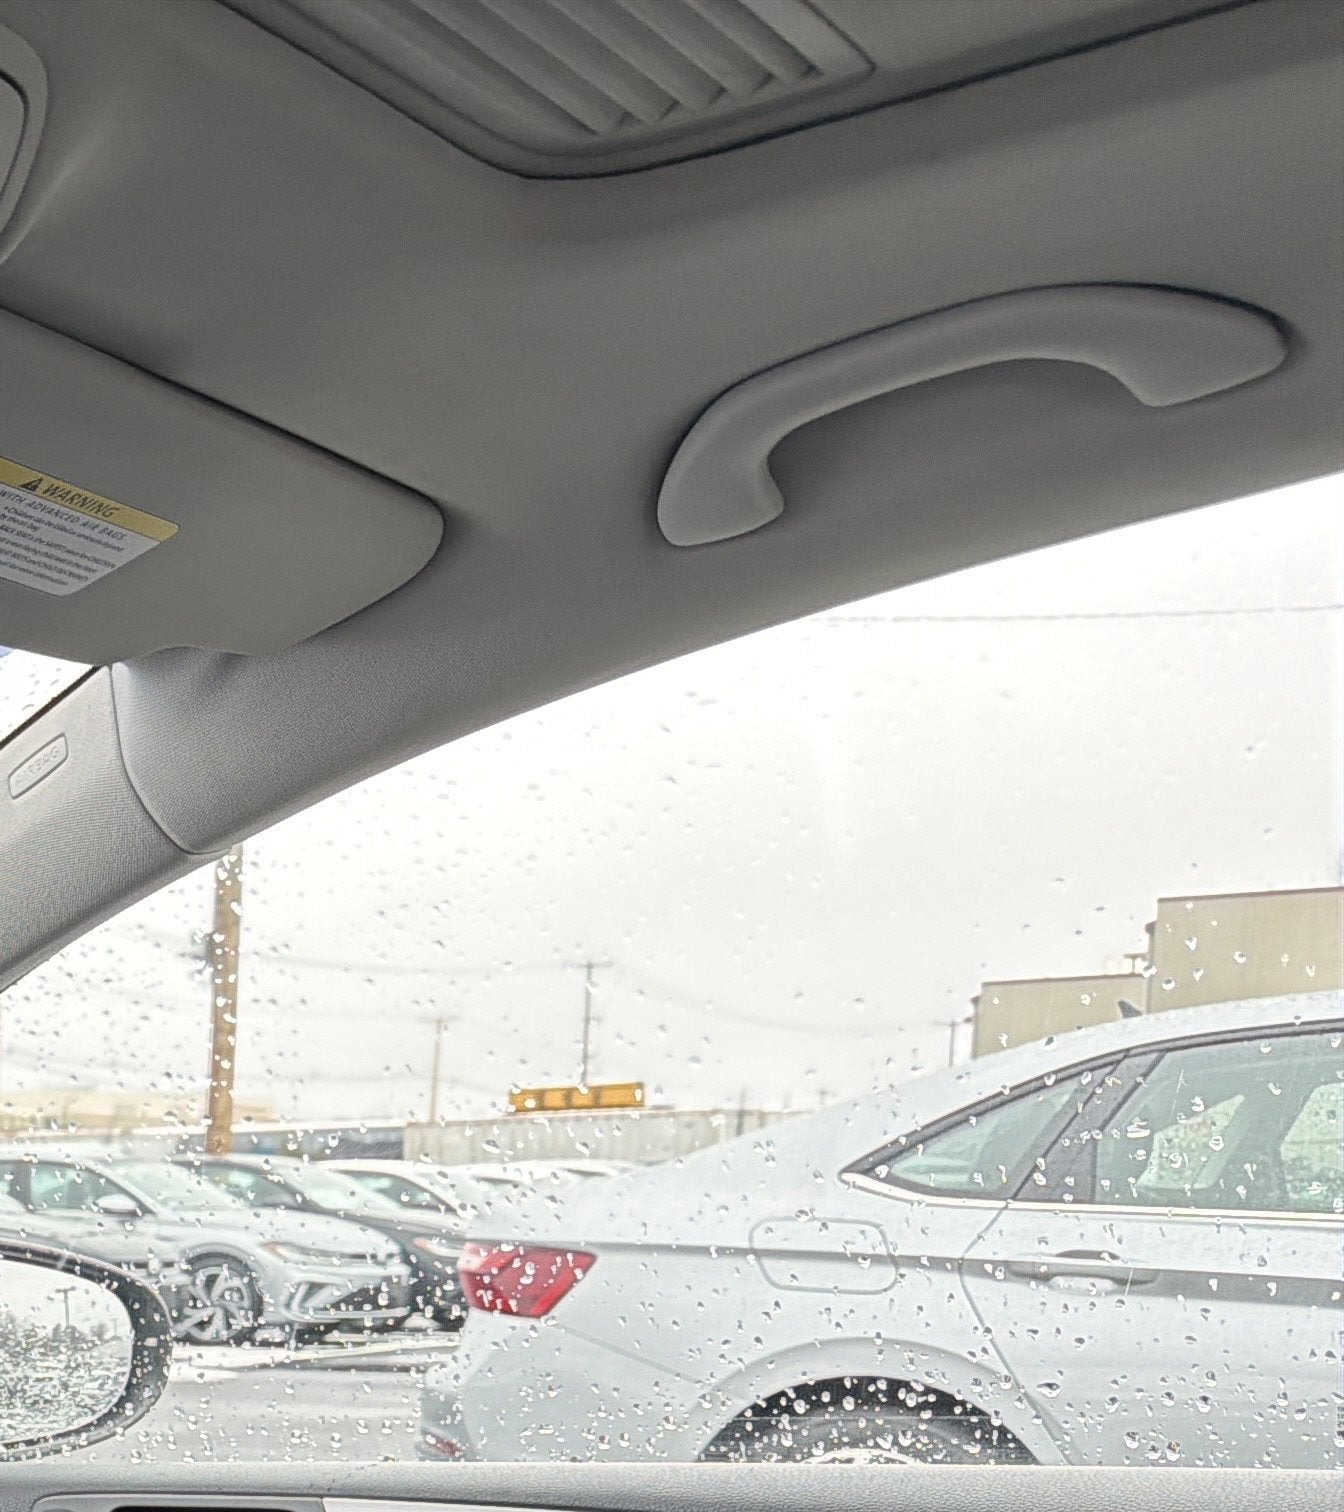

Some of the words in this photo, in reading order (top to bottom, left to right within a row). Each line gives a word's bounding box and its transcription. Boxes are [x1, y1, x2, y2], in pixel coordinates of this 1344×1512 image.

[42, 483, 120, 518] WARNING
[26, 501, 81, 523] ADVANCED
[79, 520, 99, 531] AIR
[98, 527, 127, 540] BAGS
